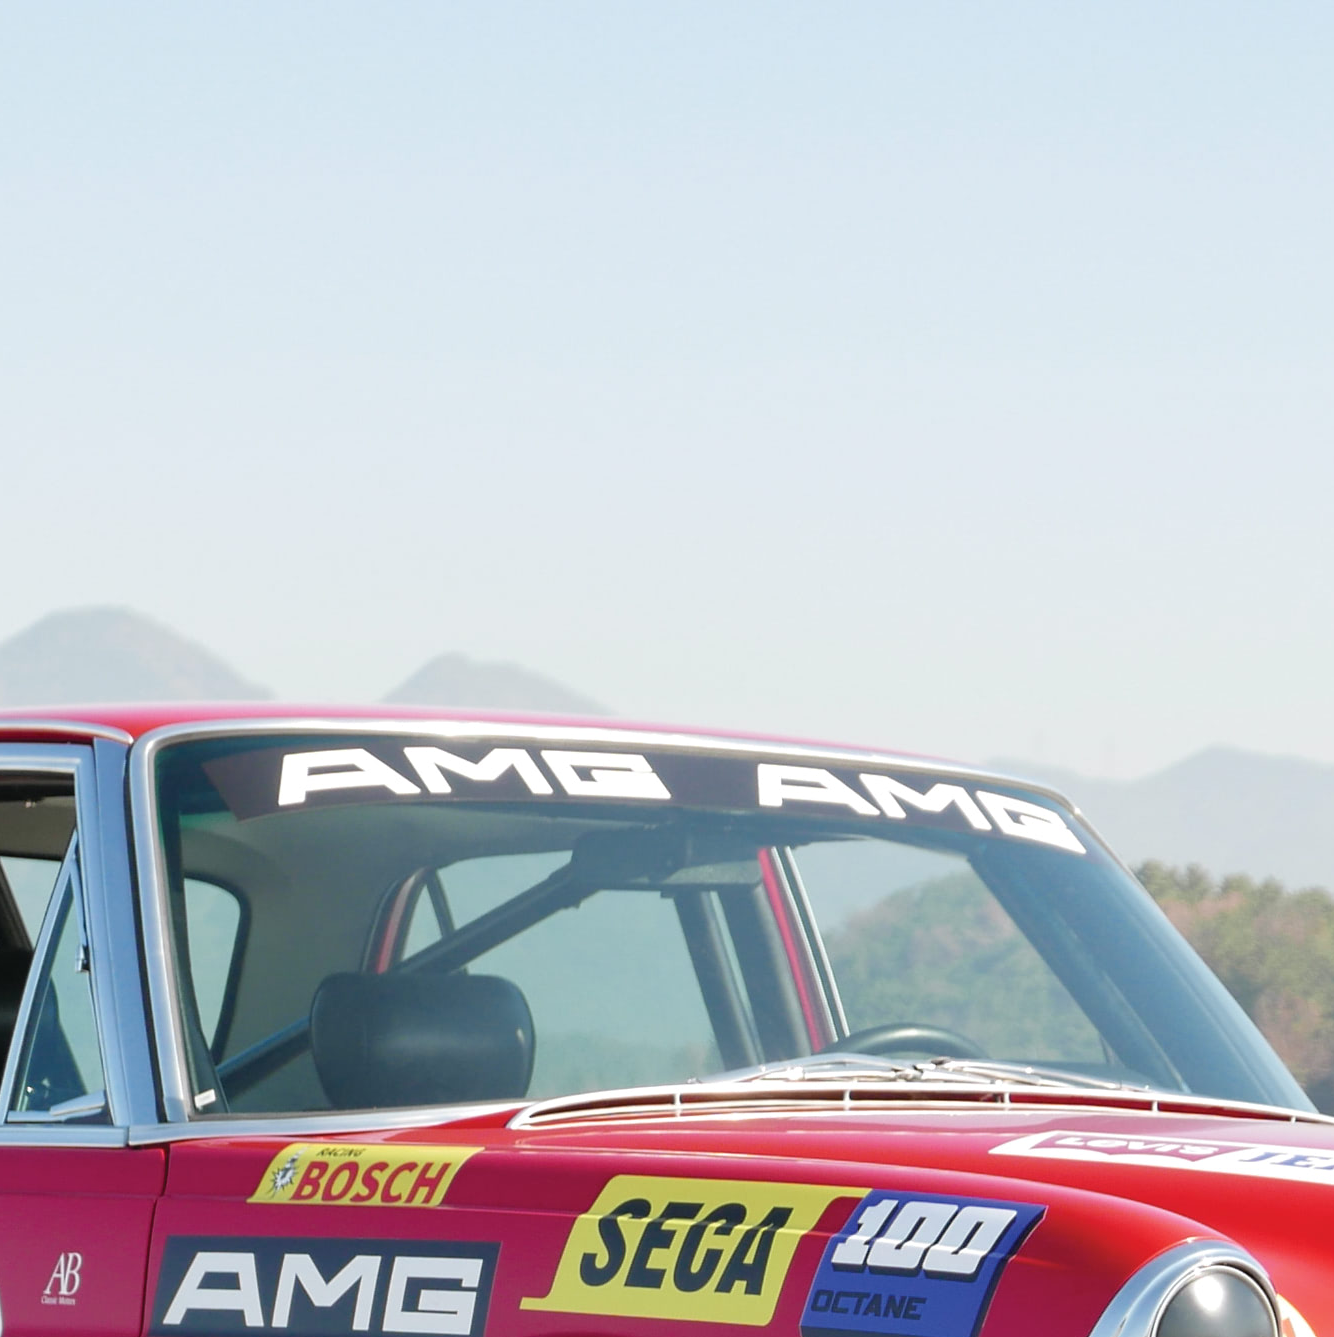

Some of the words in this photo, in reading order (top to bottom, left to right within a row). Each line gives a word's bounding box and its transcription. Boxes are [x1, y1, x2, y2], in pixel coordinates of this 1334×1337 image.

[278, 746, 671, 806] AMG
[757, 763, 1086, 854] AMG
[288, 1161, 452, 1204] BOSCH
[831, 1199, 1018, 1281] 100
[43, 1251, 82, 1295] AB
[163, 1251, 483, 1335] AMG
[810, 1290, 927, 1321] OCTANE
